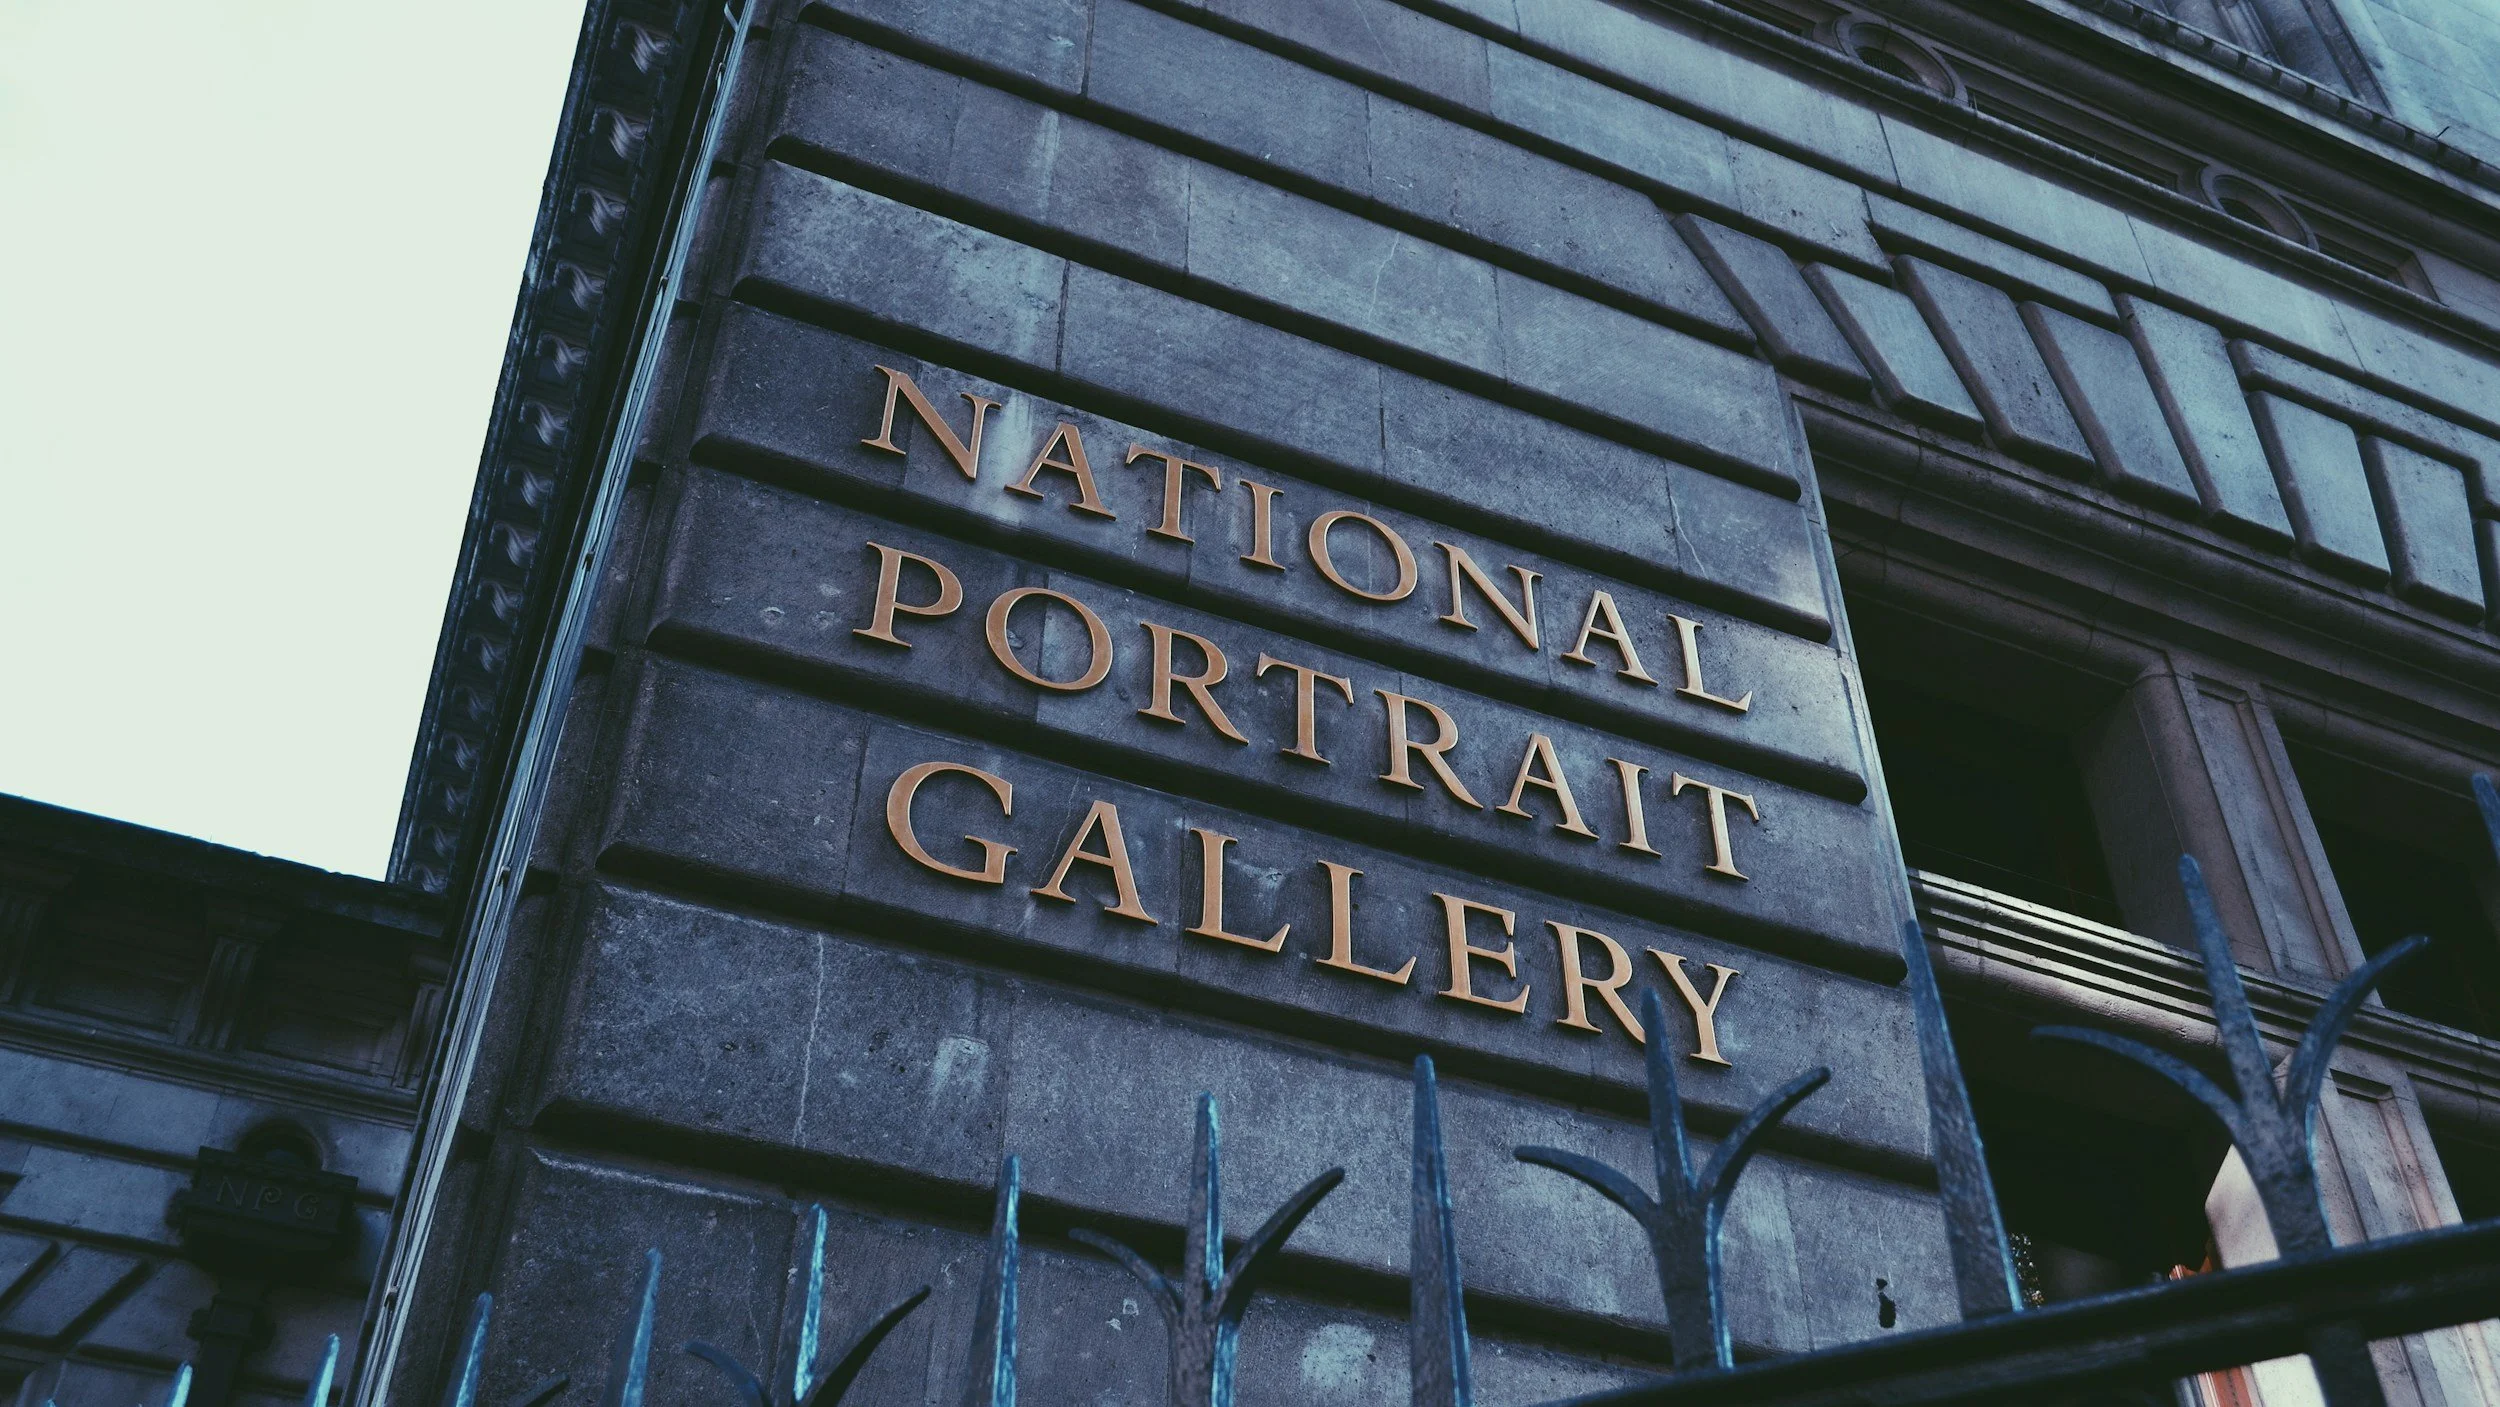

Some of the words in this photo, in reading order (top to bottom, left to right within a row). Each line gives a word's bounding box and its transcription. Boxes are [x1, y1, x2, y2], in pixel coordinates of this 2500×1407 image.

[861, 365, 1753, 713] NATIONAL
[853, 541, 1759, 881] PORTRAIT
[886, 761, 1741, 1067] GALLERY
[215, 1176, 320, 1220] NPG
